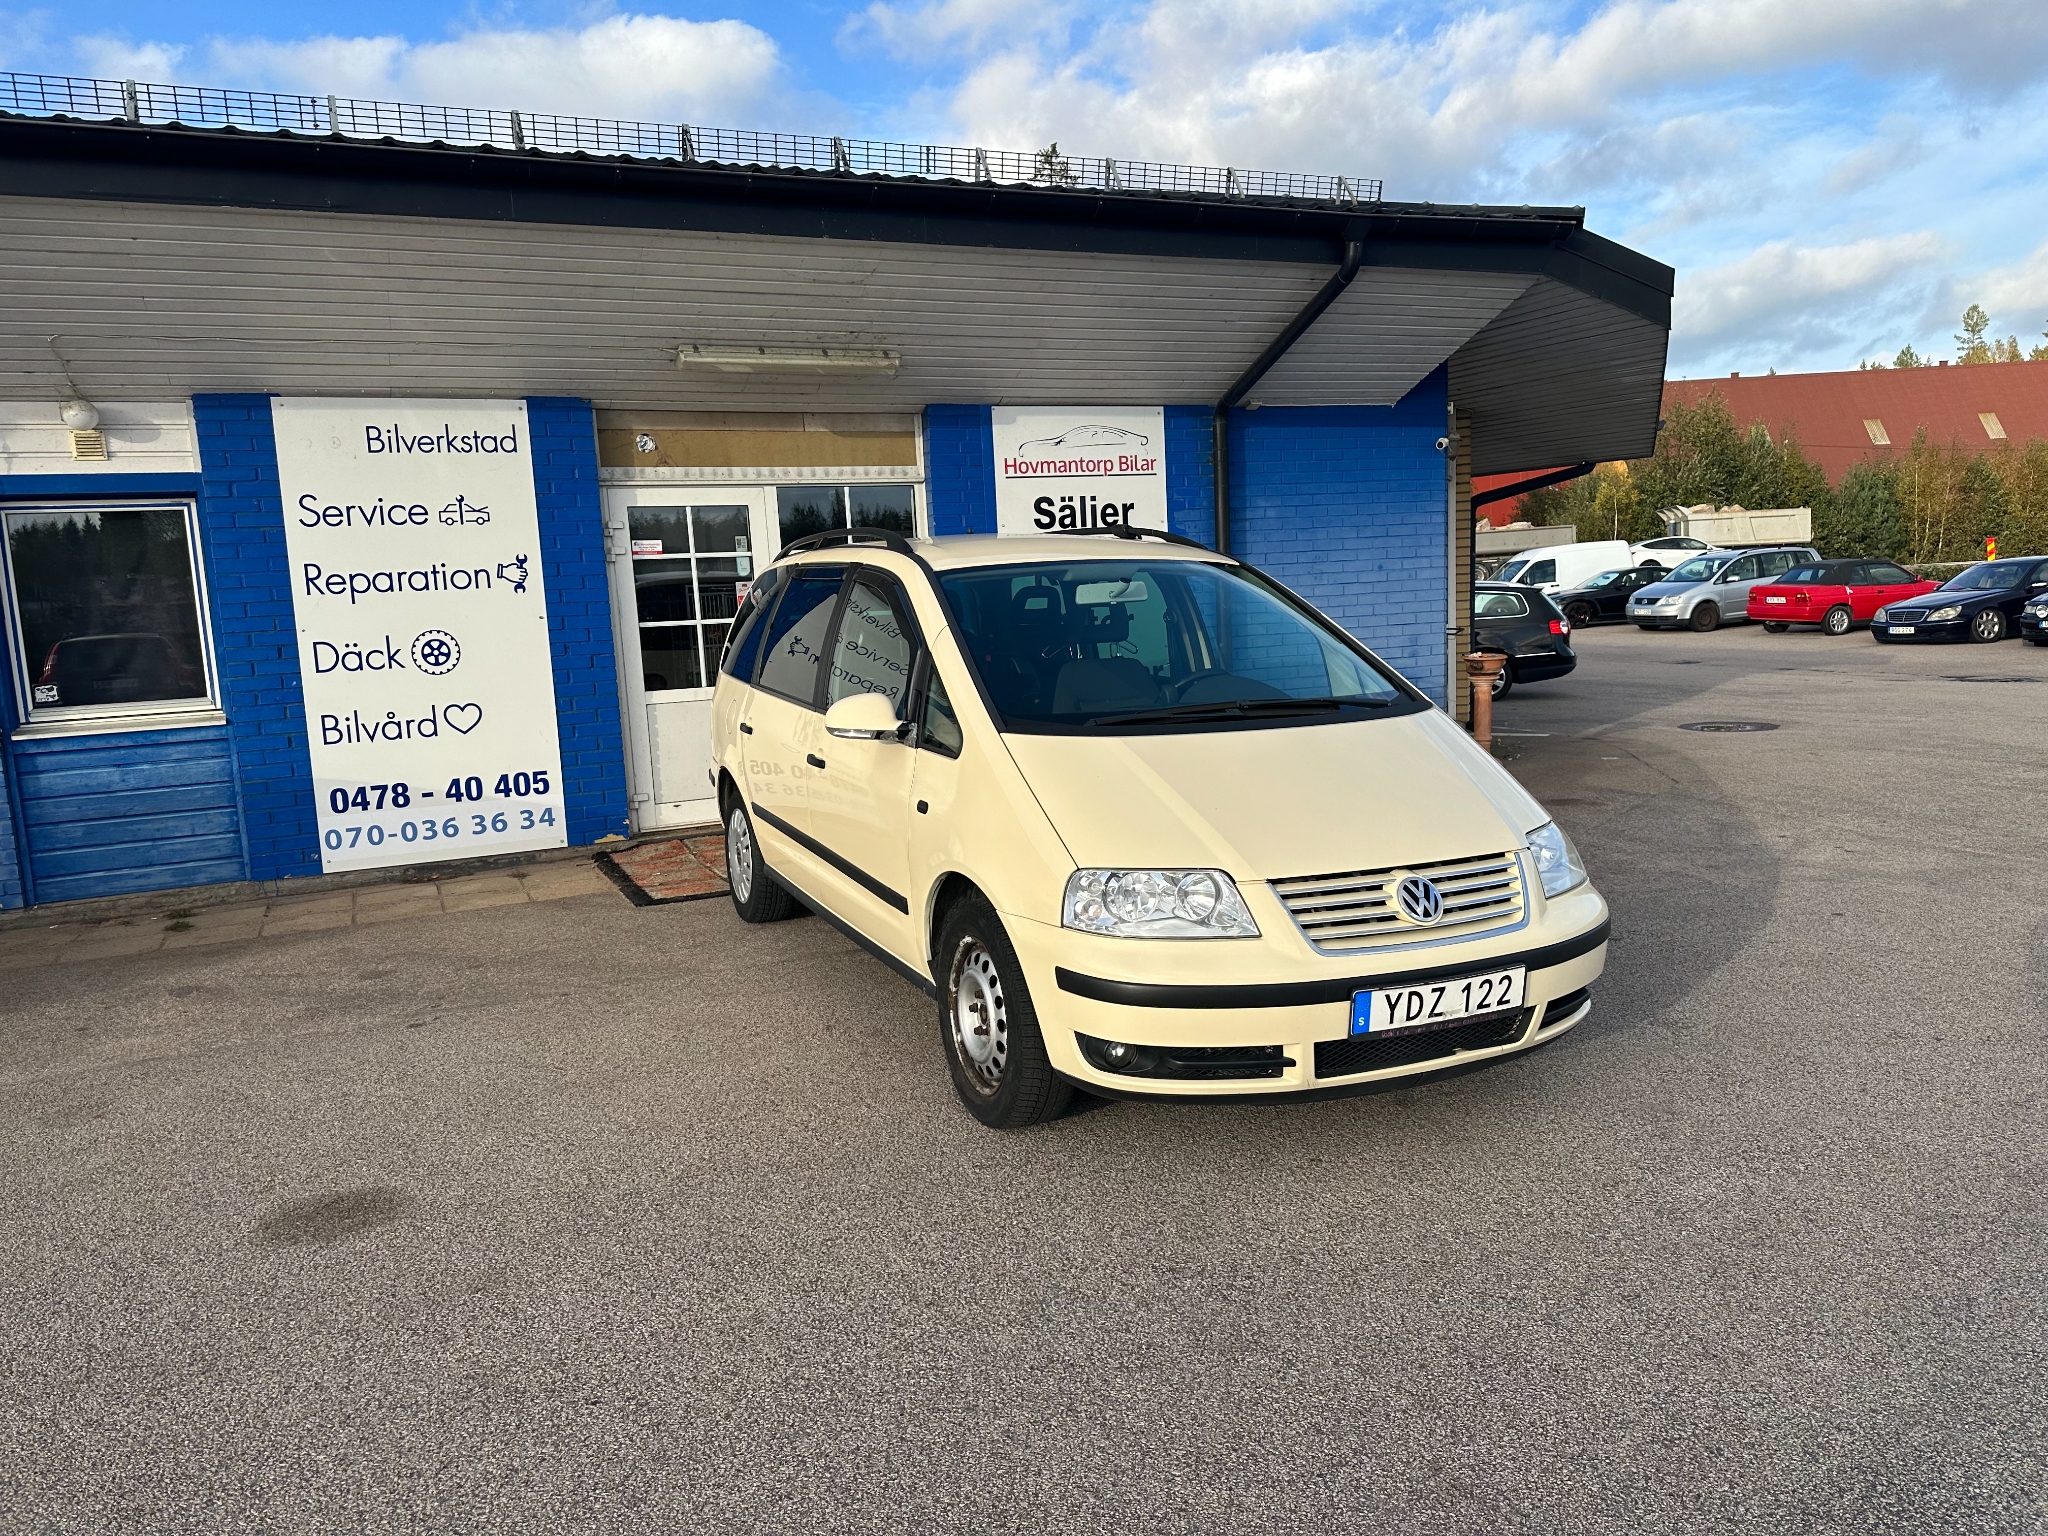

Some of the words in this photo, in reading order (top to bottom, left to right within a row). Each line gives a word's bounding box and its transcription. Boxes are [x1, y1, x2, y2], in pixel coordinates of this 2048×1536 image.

[366, 424, 517, 454] Bilverkstad
[1004, 457, 1113, 476] Hovmantorp
[1119, 455, 1156, 471] Bilar
[299, 494, 428, 527] Service
[304, 563, 491, 604] Reparation
[313, 635, 406, 673] Däck
[321, 705, 438, 745] Bilvård
[330, 783, 410, 813] 0478
[446, 777, 483, 802] 40
[495, 771, 549, 797] 405
[325, 817, 459, 850] 070-036
[472, 812, 507, 834] 36
[520, 808, 555, 829] 34
[1385, 987, 1445, 1024] YDZ
[1462, 975, 1512, 1012] 122
[1359, 1017, 1364, 1025] S
